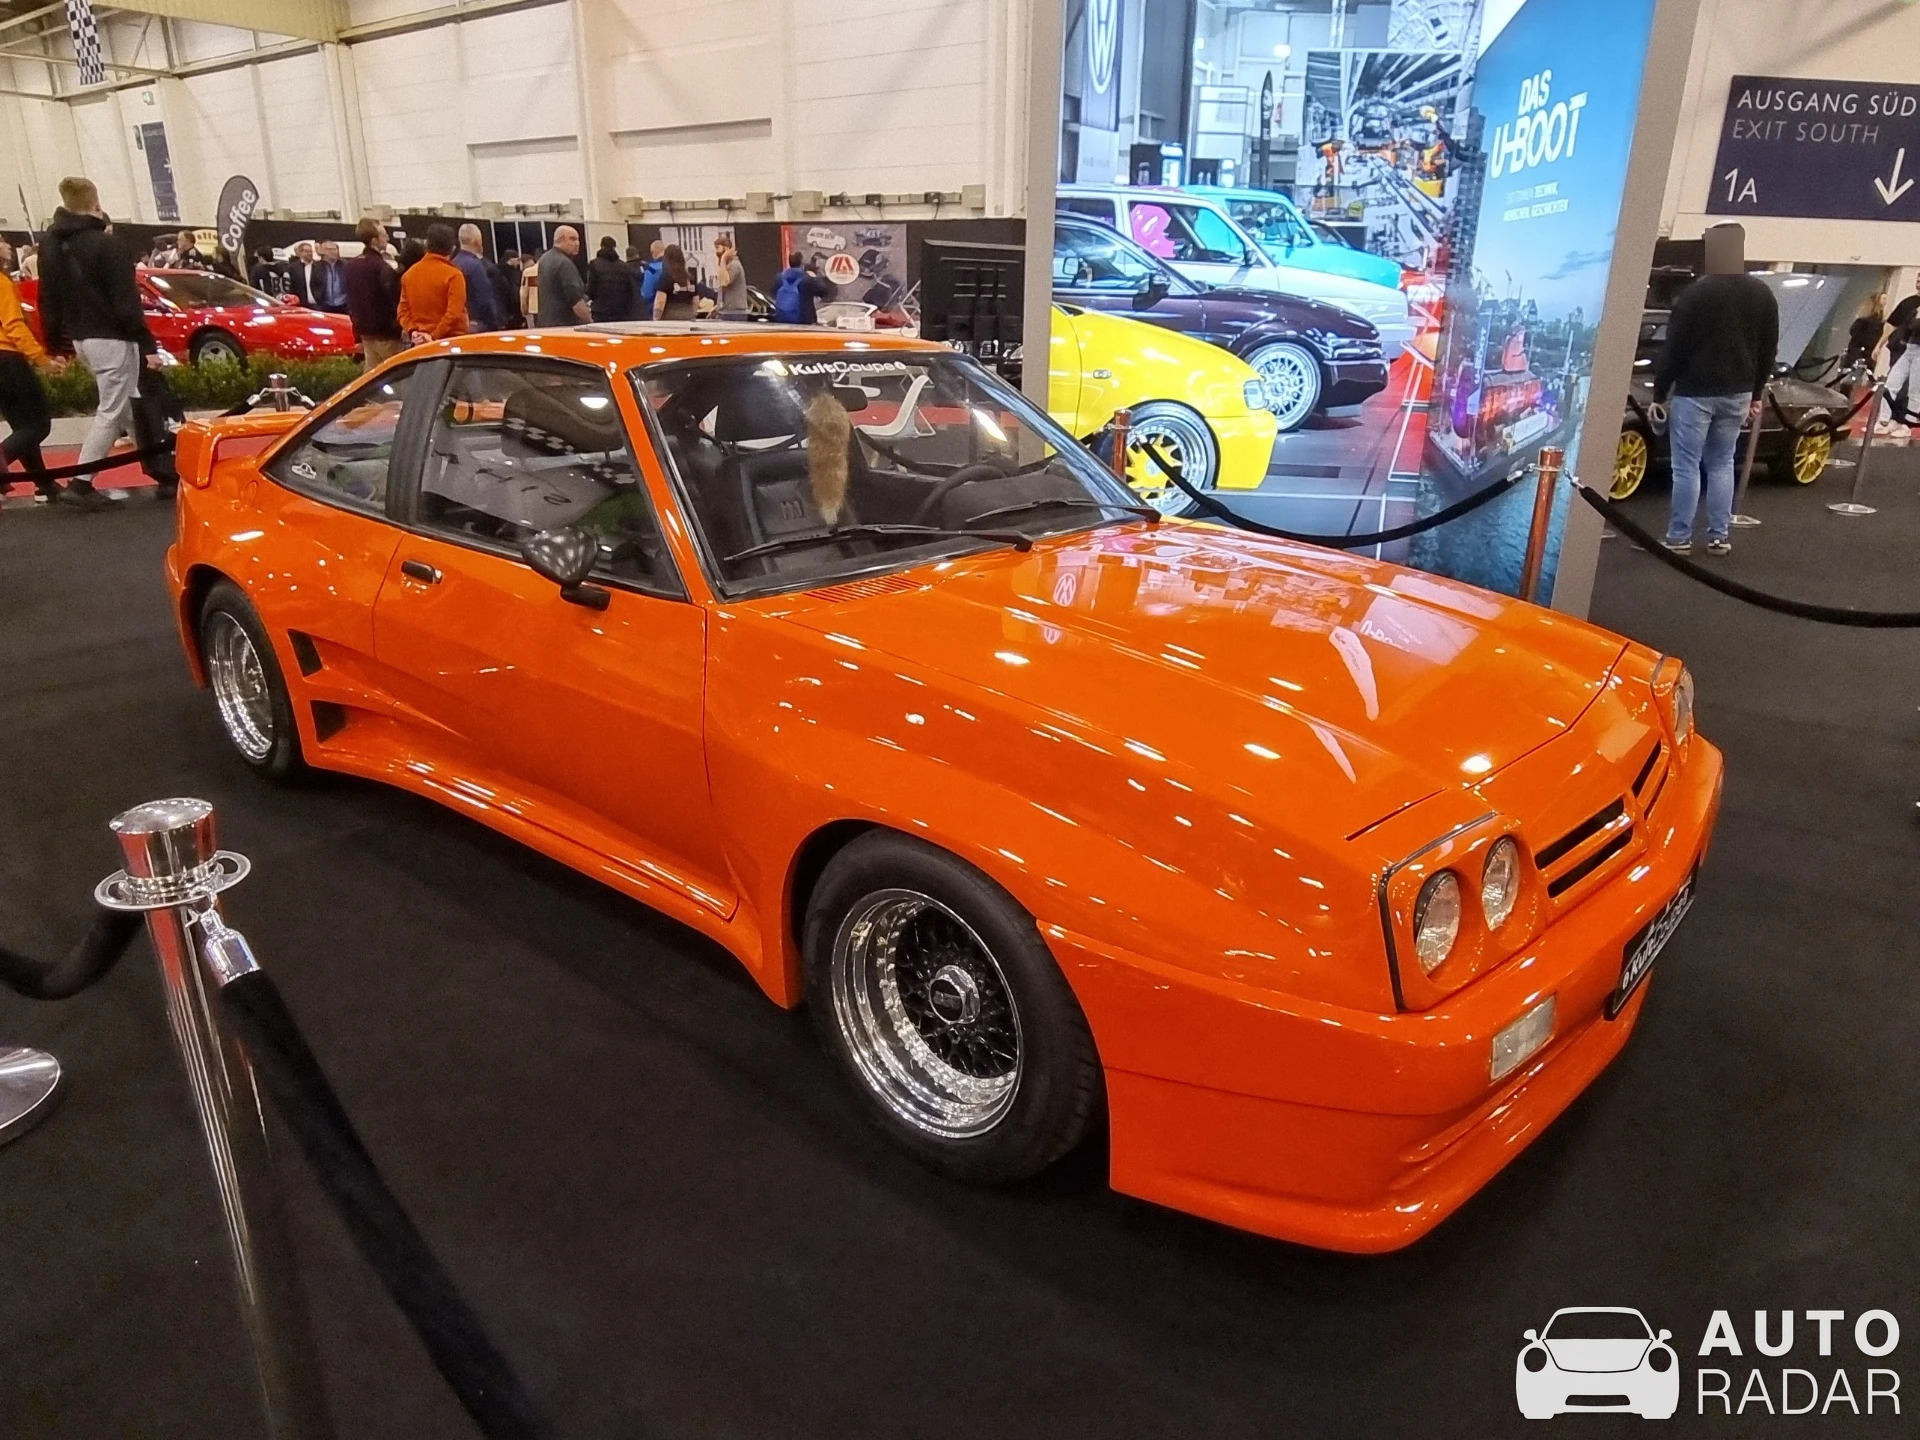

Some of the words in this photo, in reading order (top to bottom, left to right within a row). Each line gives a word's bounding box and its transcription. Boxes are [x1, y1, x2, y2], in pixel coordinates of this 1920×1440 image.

[1518, 70, 1552, 116] DAS
[1737, 90, 1858, 114] AUSGANG
[1868, 91, 1916, 116] SÜD
[1491, 91, 1587, 179] U-BOOT
[1733, 119, 1787, 141] EXIT
[1796, 122, 1879, 144] SOUTH
[1725, 168, 1757, 203] 1A
[222, 189, 256, 252] Coffee
